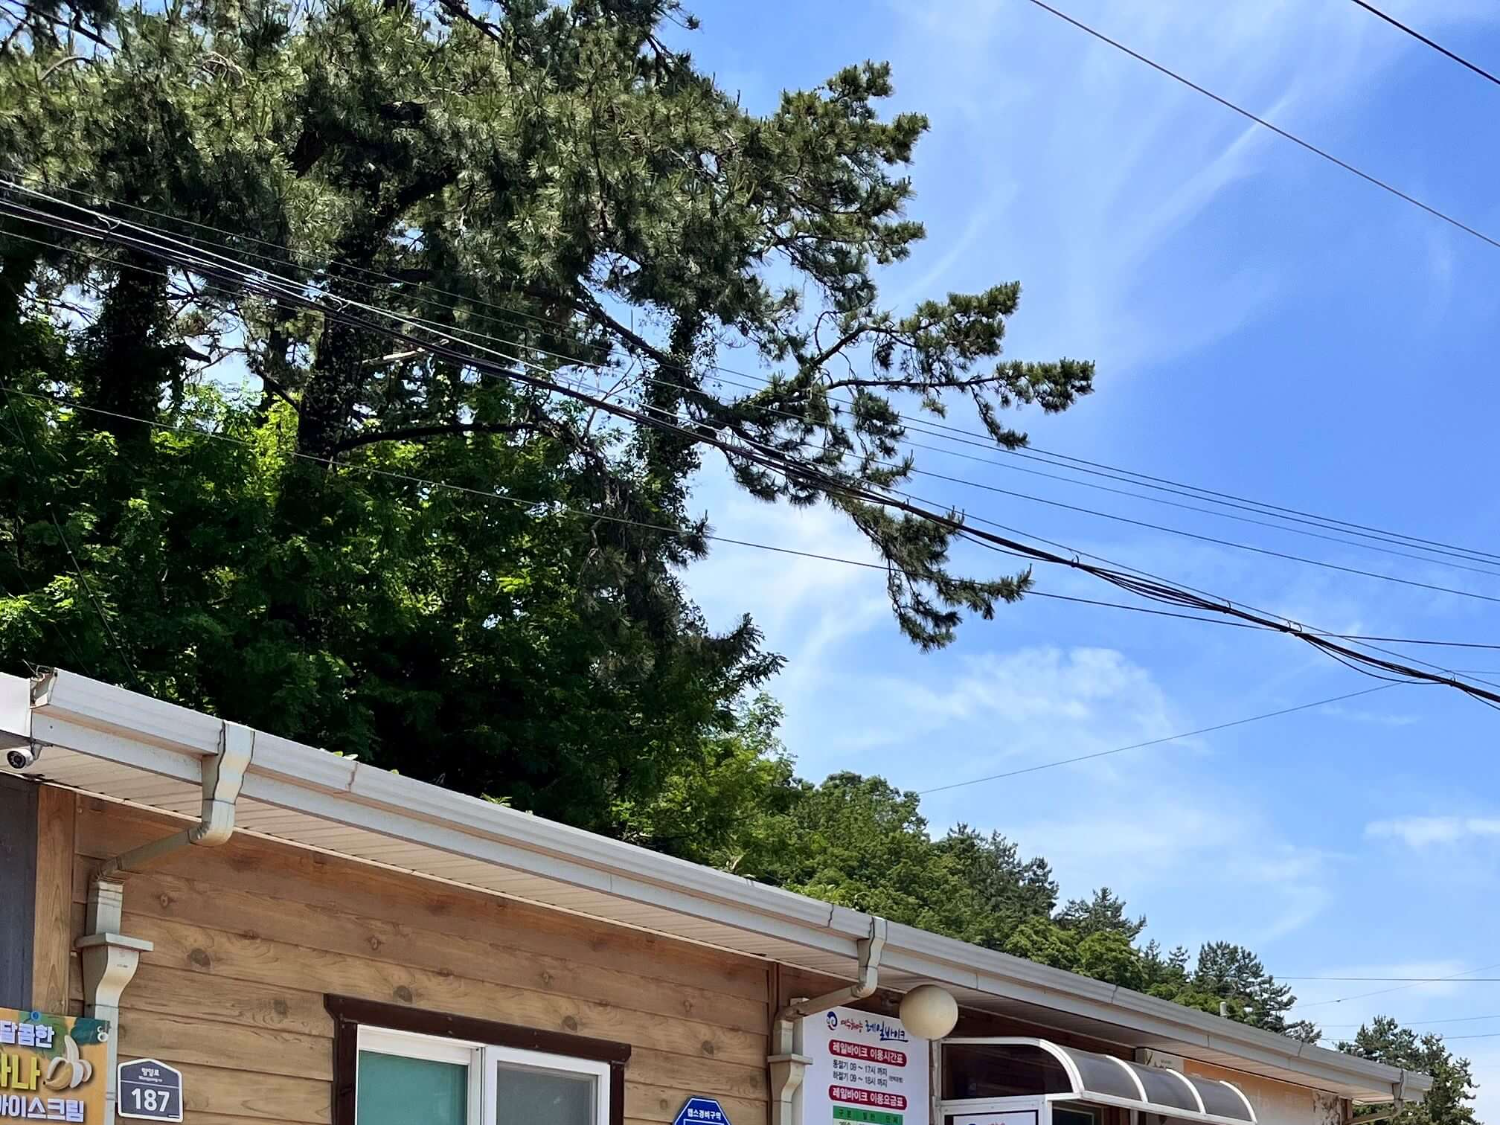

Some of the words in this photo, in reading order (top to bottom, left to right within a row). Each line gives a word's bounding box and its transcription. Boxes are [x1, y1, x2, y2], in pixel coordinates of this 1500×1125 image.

[832, 1042, 868, 1058] 레일바이크
[870, 1048, 904, 1065] 이용시간표
[131, 1087, 170, 1112] 187
[832, 1087, 868, 1102] 레일바이크
[870, 1093, 904, 1108] 이용요금표
